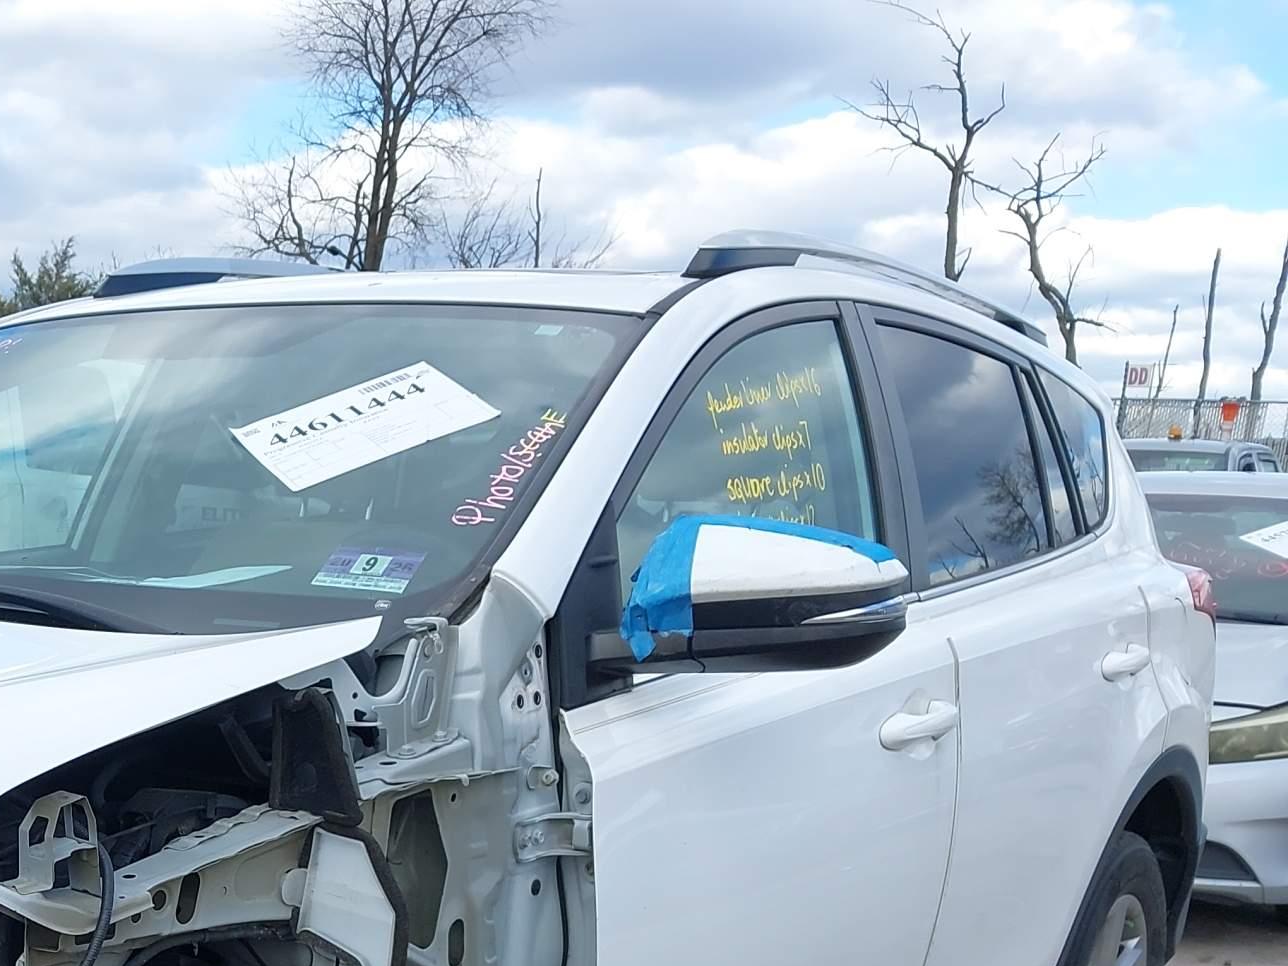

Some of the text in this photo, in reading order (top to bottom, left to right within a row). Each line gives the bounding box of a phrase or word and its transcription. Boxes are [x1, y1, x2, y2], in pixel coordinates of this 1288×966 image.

[1128, 367, 1149, 386] DD
[269, 381, 426, 446] 44611444
[726, 475, 775, 505] square
[361, 556, 379, 572] 9
